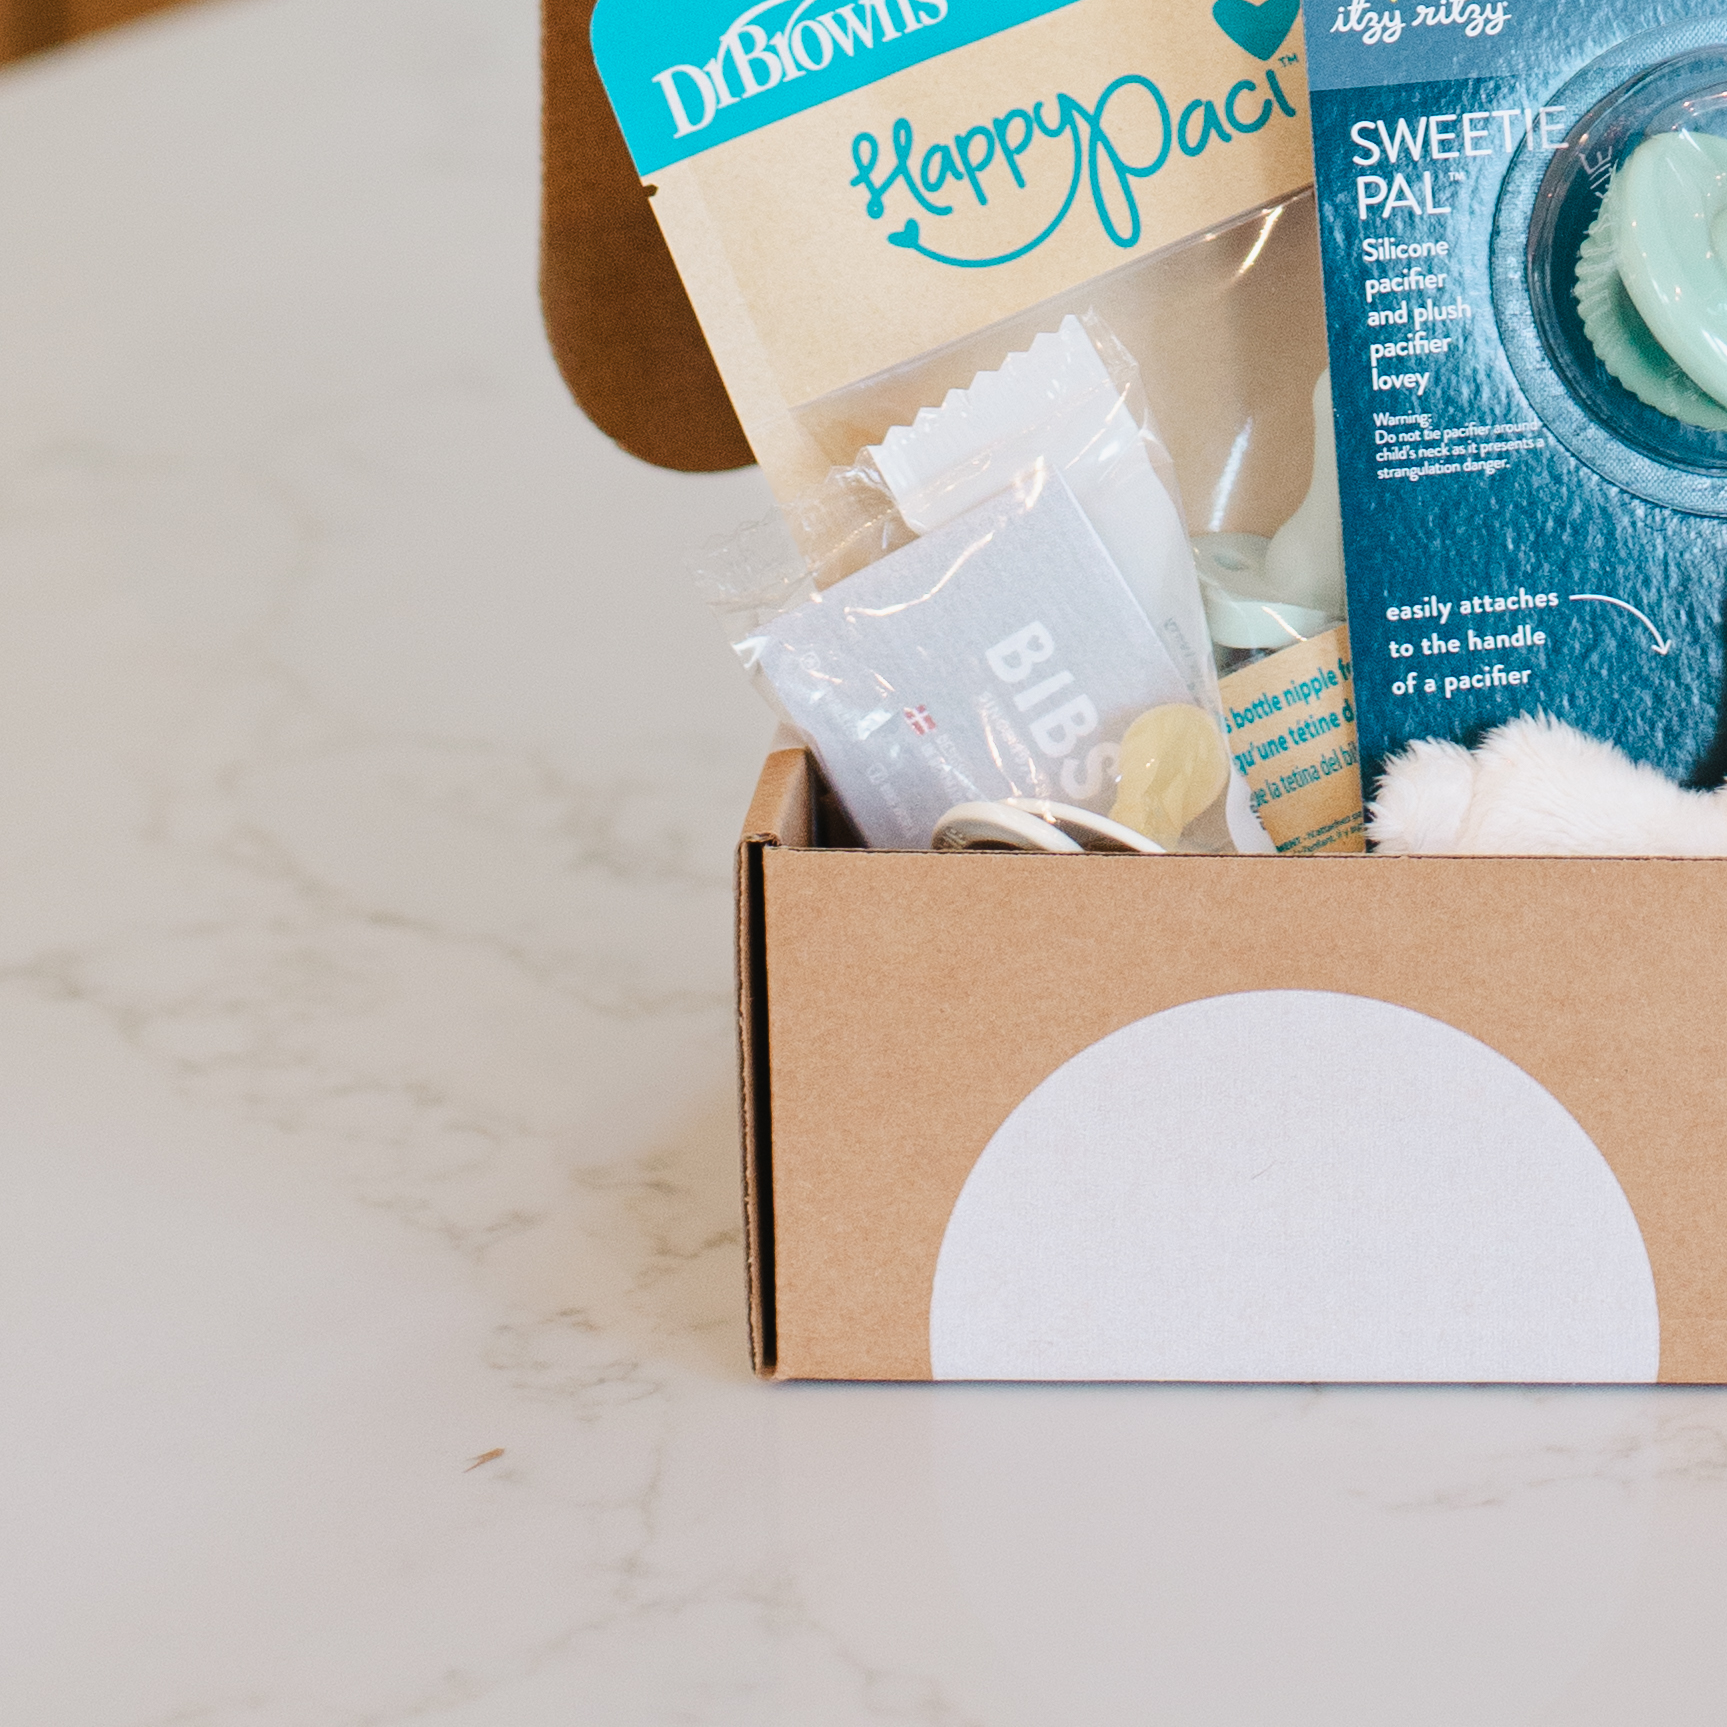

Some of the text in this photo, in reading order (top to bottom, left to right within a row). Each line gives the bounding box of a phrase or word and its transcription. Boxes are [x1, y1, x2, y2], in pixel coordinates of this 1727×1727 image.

[1350, 106, 1569, 166] SWEETIE
[1362, 237, 1449, 262] Silicone
[1365, 267, 1448, 303] pacifier
[1367, 296, 1472, 330] and plush
[1370, 332, 1452, 367] pacifier
[1372, 368, 1430, 396] lovey
[1373, 410, 1433, 428] Warning:
[1375, 418, 1540, 445] Do not tie pacifier around
[1376, 437, 1545, 462] child's neck as it presents a
[1377, 457, 1511, 481] strangulation danger.
[1386, 587, 1559, 624] easily attaches
[1389, 624, 1547, 658] to the handle
[1229, 692, 1282, 729] bottle
[1283, 667, 1339, 705] nipple
[1391, 664, 1532, 698] of a pacifier
[986, 622, 1123, 800] BIBS
[1232, 741, 1289, 776] qu'une
[1288, 712, 1341, 746] tétine
[1265, 779, 1283, 800] la
[1280, 761, 1321, 794] tetina
[1320, 748, 1342, 776] del
